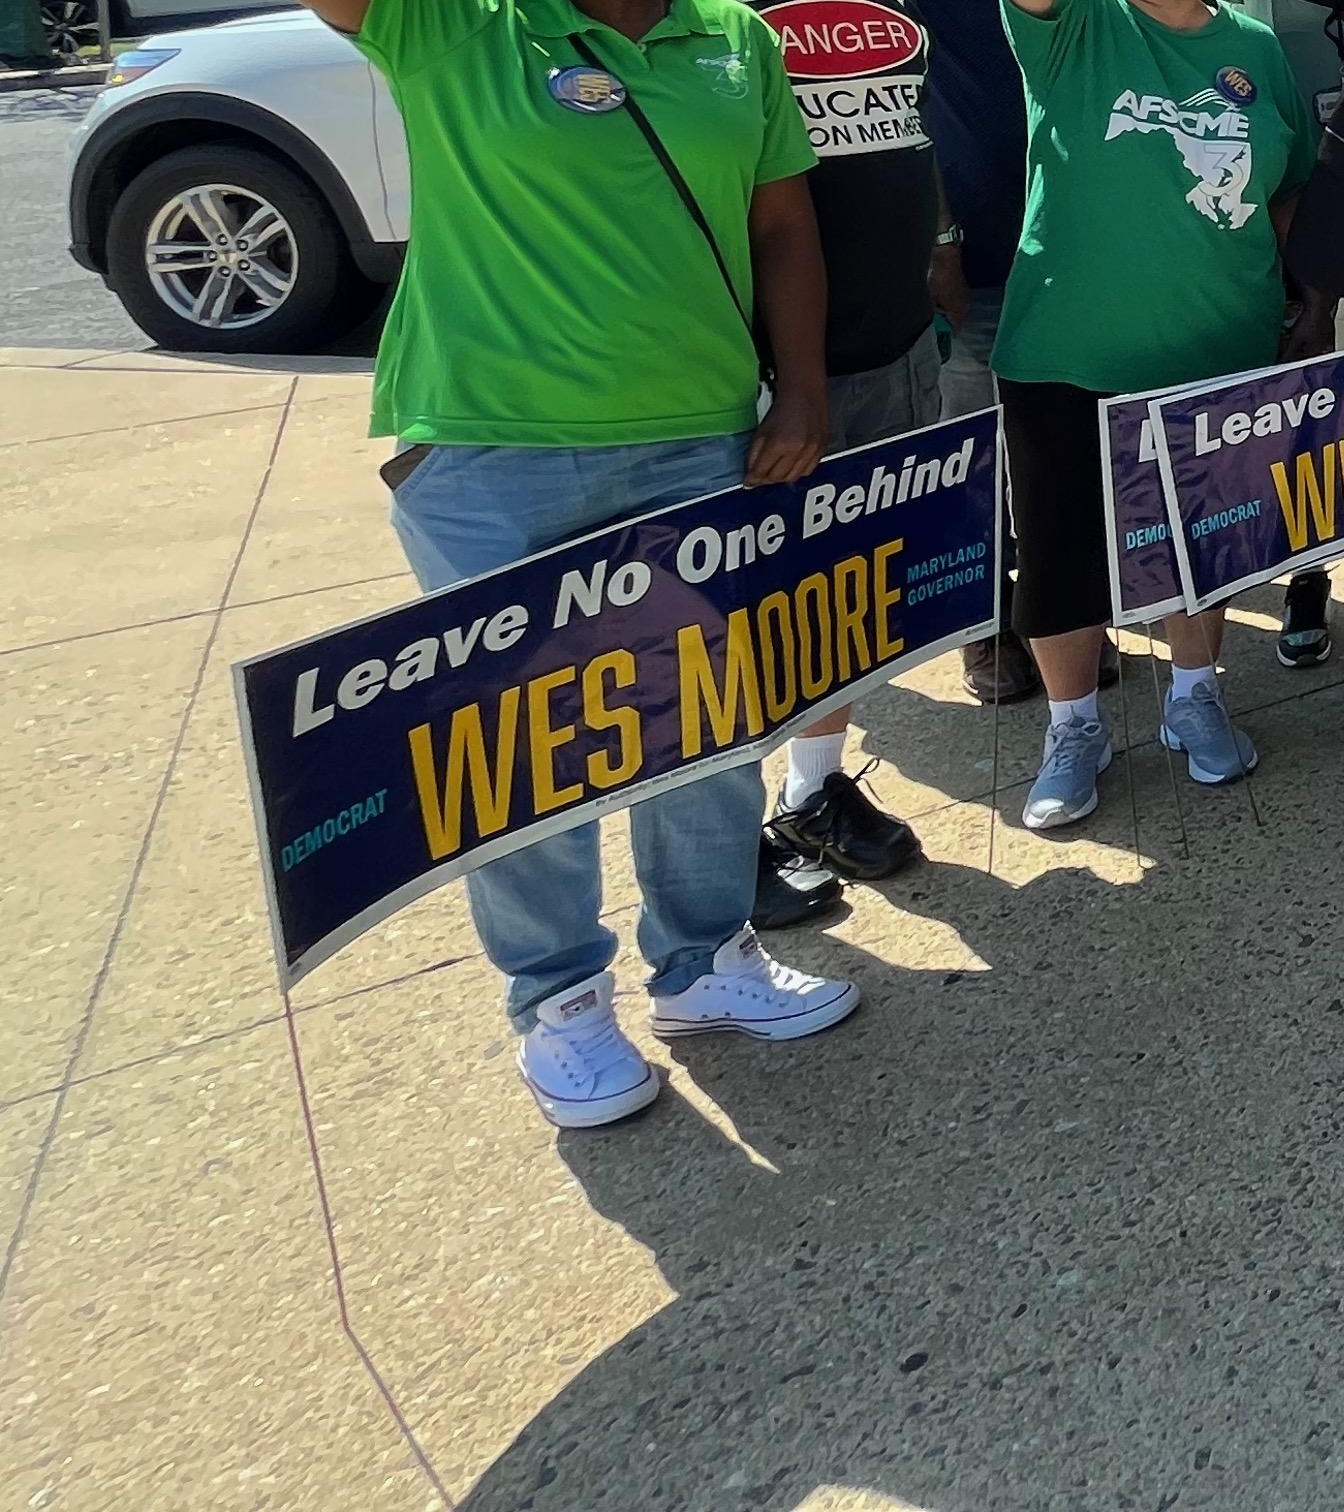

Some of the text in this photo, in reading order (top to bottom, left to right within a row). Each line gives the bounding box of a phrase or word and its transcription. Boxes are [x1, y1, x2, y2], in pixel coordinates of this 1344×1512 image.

[781, 20, 912, 56] ANGER
[796, 84, 922, 120] UCATE
[1225, 69, 1253, 97] WES
[1113, 89, 1249, 138] AFSCME
[1199, 143, 1244, 197] 3
[1194, 383, 1335, 457] Leave
[1125, 523, 1174, 550] DEMO
[1191, 499, 1262, 540] DEMOCRAT
[906, 542, 988, 584] MARYLAND
[293, 437, 976, 739] Leave No One Behind
[906, 564, 987, 607] GOVERNOR
[408, 648, 643, 861] WES
[676, 538, 906, 758] MOORE
[280, 788, 389, 873] DEMOCRAT
